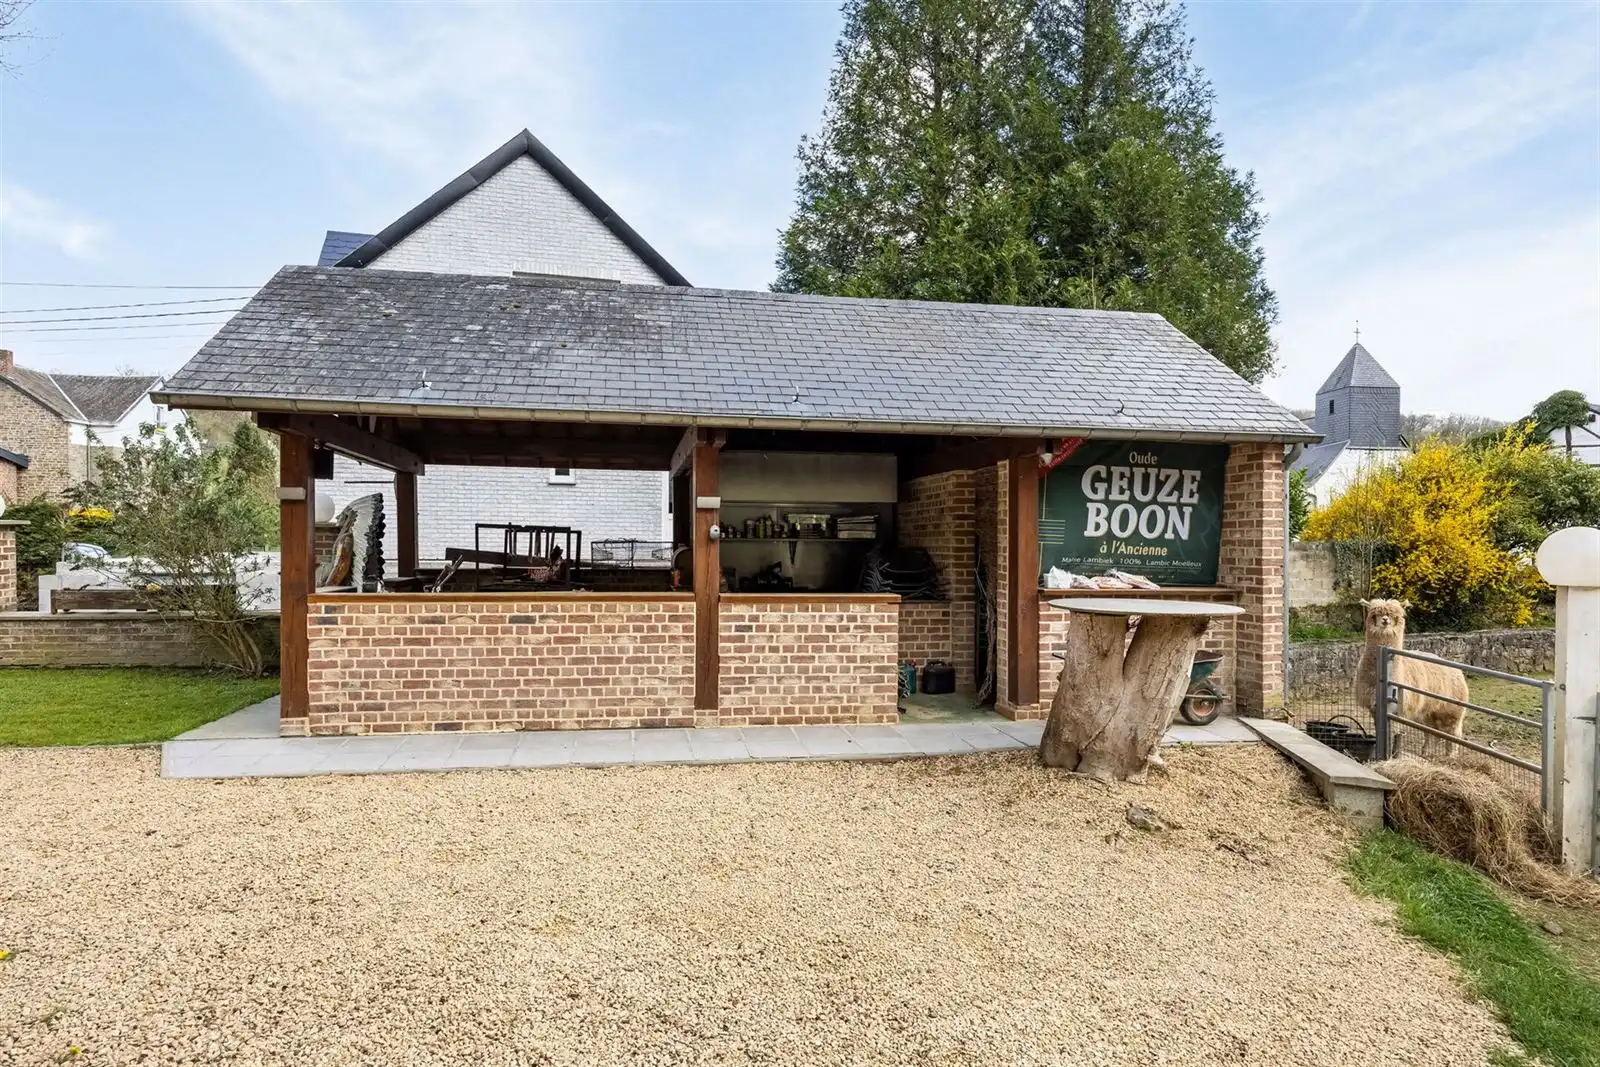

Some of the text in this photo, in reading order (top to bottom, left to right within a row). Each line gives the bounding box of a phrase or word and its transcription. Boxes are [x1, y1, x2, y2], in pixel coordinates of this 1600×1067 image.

[1129, 451, 1158, 465] Oude
[1081, 465, 1202, 504] GEUZE
[1084, 502, 1193, 540] BOON
[1099, 540, 1168, 556] à l'Ancienne
